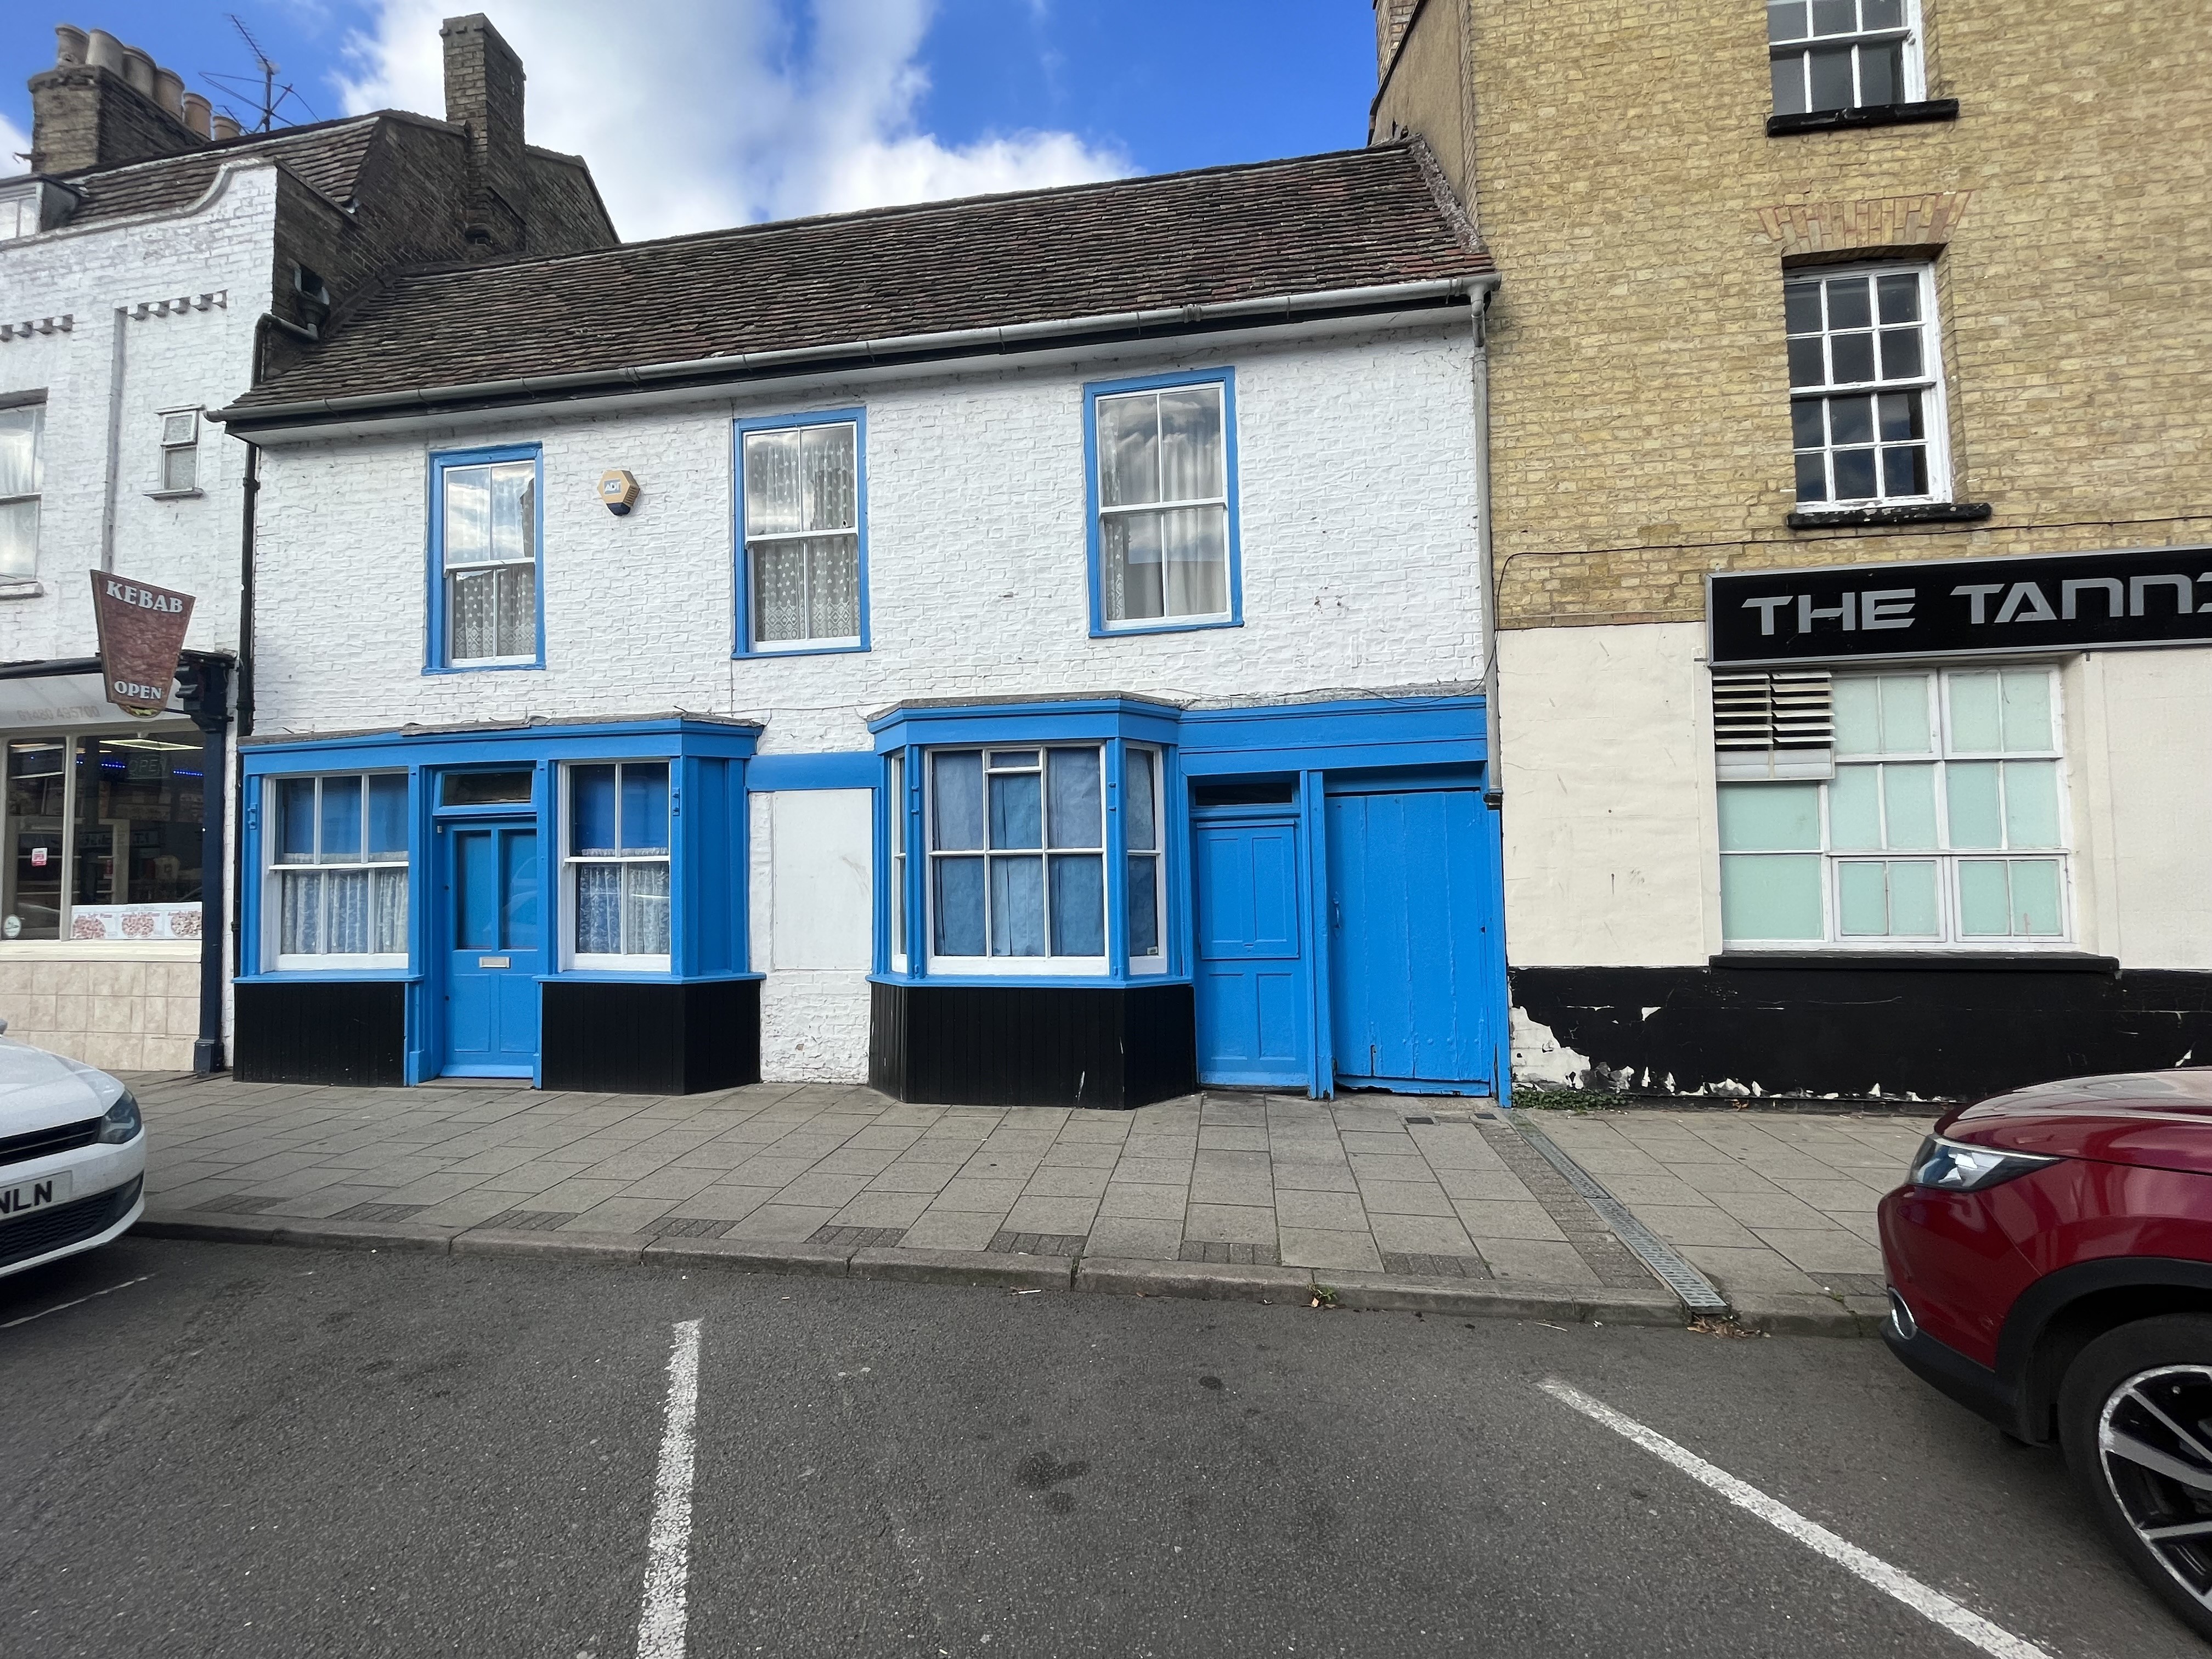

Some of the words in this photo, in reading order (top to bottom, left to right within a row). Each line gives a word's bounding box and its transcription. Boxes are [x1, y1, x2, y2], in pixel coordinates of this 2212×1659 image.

[605, 481, 621, 492] ADT
[106, 580, 184, 613] KEBAB
[1741, 588, 1916, 635] THE
[114, 680, 162, 700] OPEN
